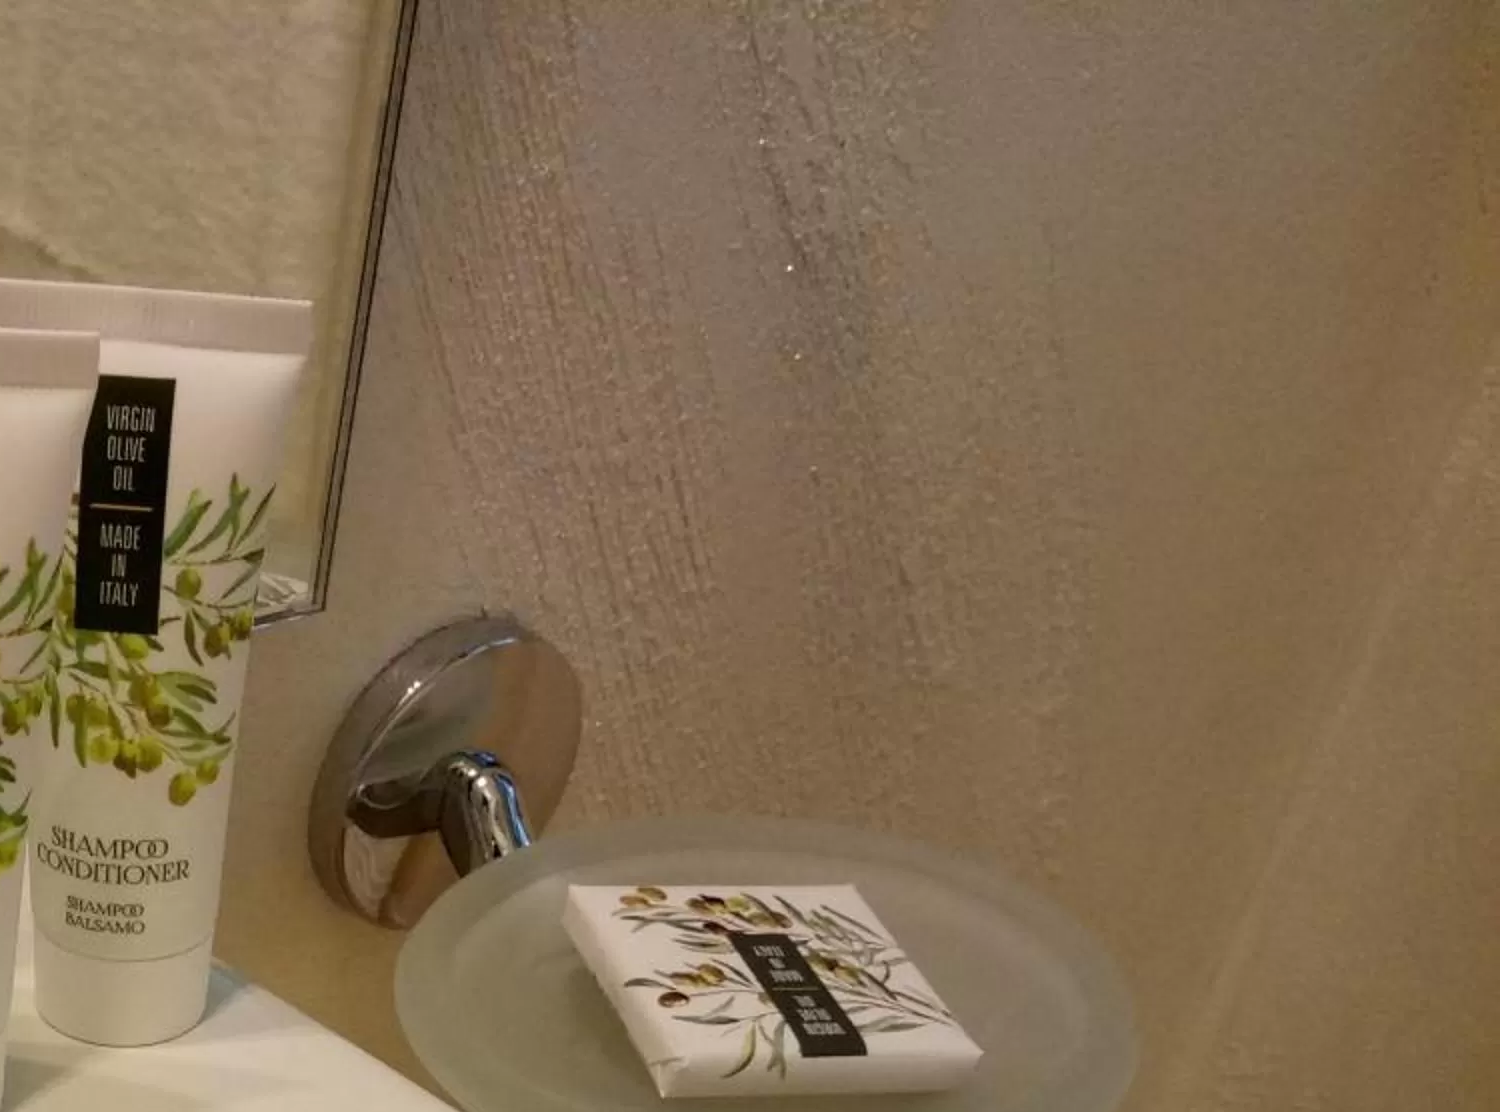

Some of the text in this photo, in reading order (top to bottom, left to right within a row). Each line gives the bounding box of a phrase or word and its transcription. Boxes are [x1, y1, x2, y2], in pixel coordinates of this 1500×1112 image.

[107, 404, 156, 433] VIRGIN
[107, 436, 146, 462] OLIVE
[113, 465, 135, 492] OIL
[100, 524, 141, 550] MADE
[111, 553, 127, 577] IN
[99, 581, 139, 607] ITALY
[51, 825, 169, 860] SHAMPOO
[37, 842, 190, 885] CONDITIONER
[66, 895, 145, 917] SHAMPOO
[65, 912, 146, 934] BALSAMO
